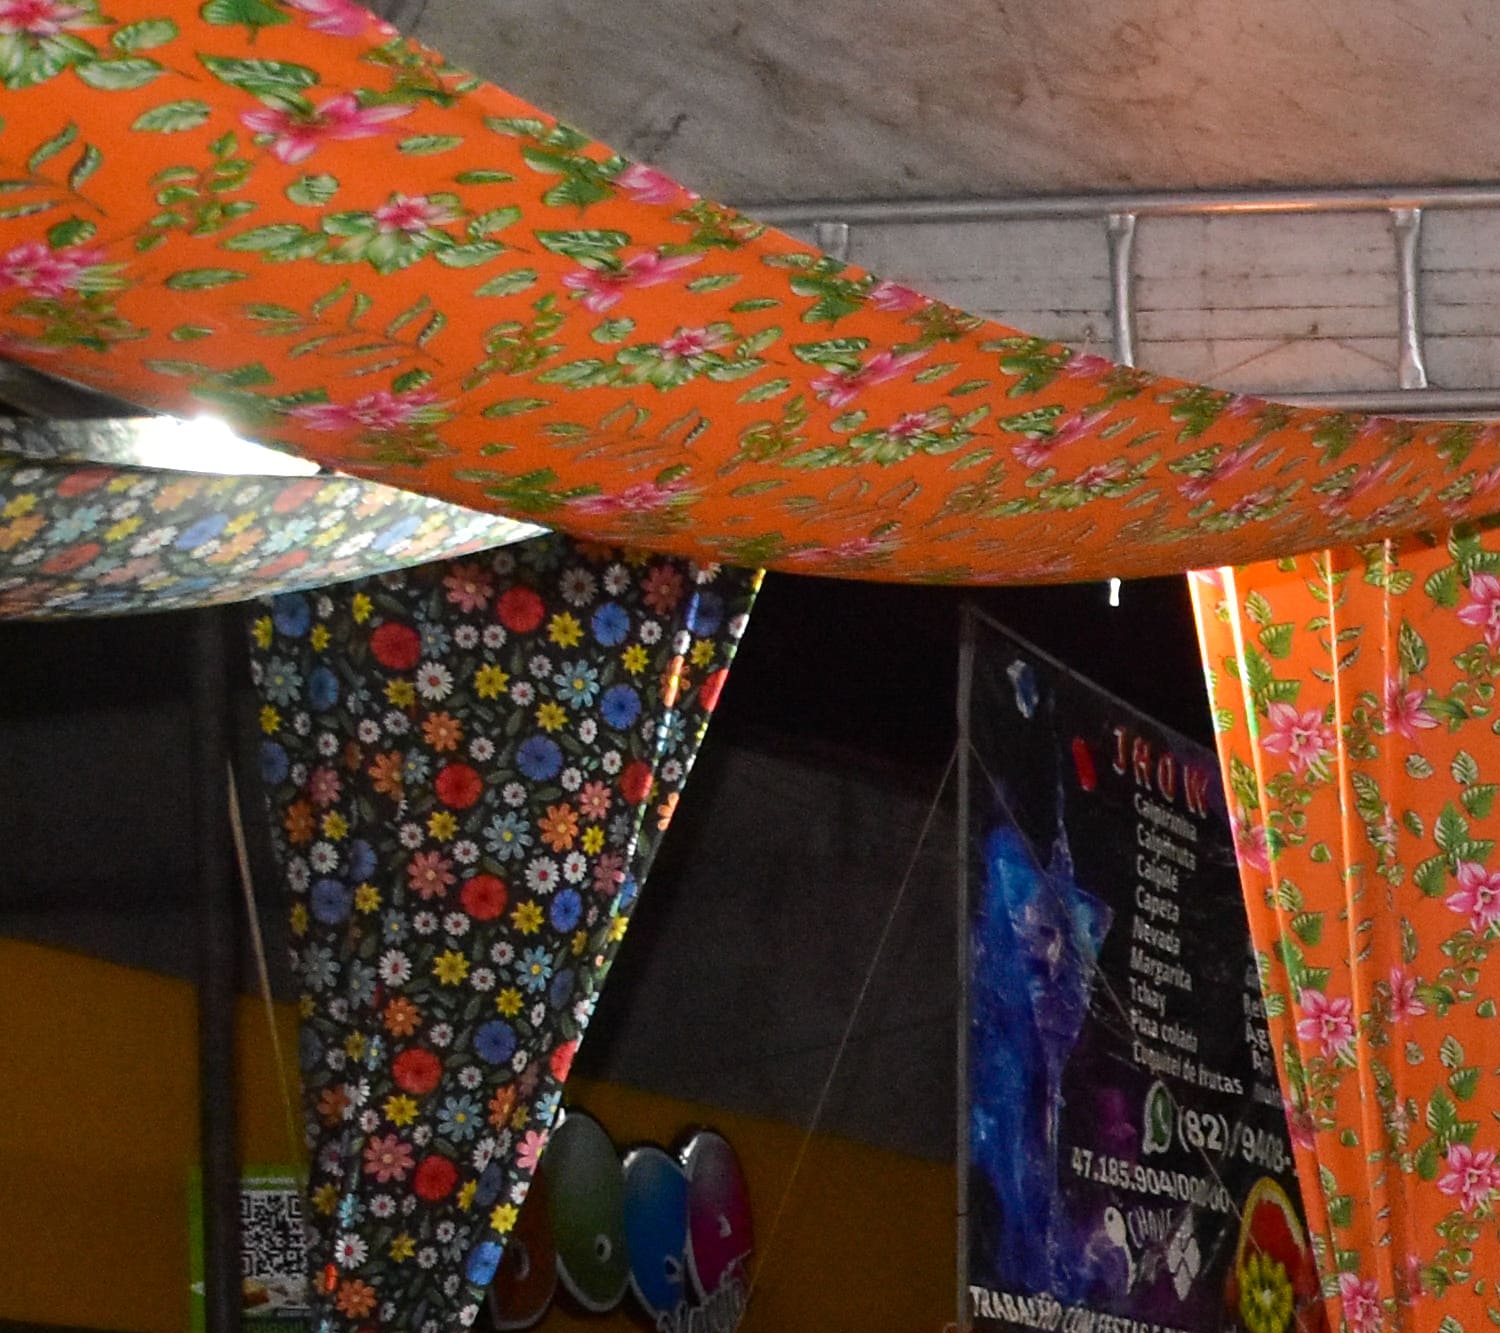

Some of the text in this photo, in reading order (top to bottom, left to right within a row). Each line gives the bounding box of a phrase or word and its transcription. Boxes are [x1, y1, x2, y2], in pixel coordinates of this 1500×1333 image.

[1136, 885, 1179, 922] Capeta
[1132, 915, 1181, 955] Nevada
[1130, 946, 1192, 991] Margarita
[1199, 1063, 1244, 1095] frutas
[968, 1285, 1063, 1332] TRABALHO
